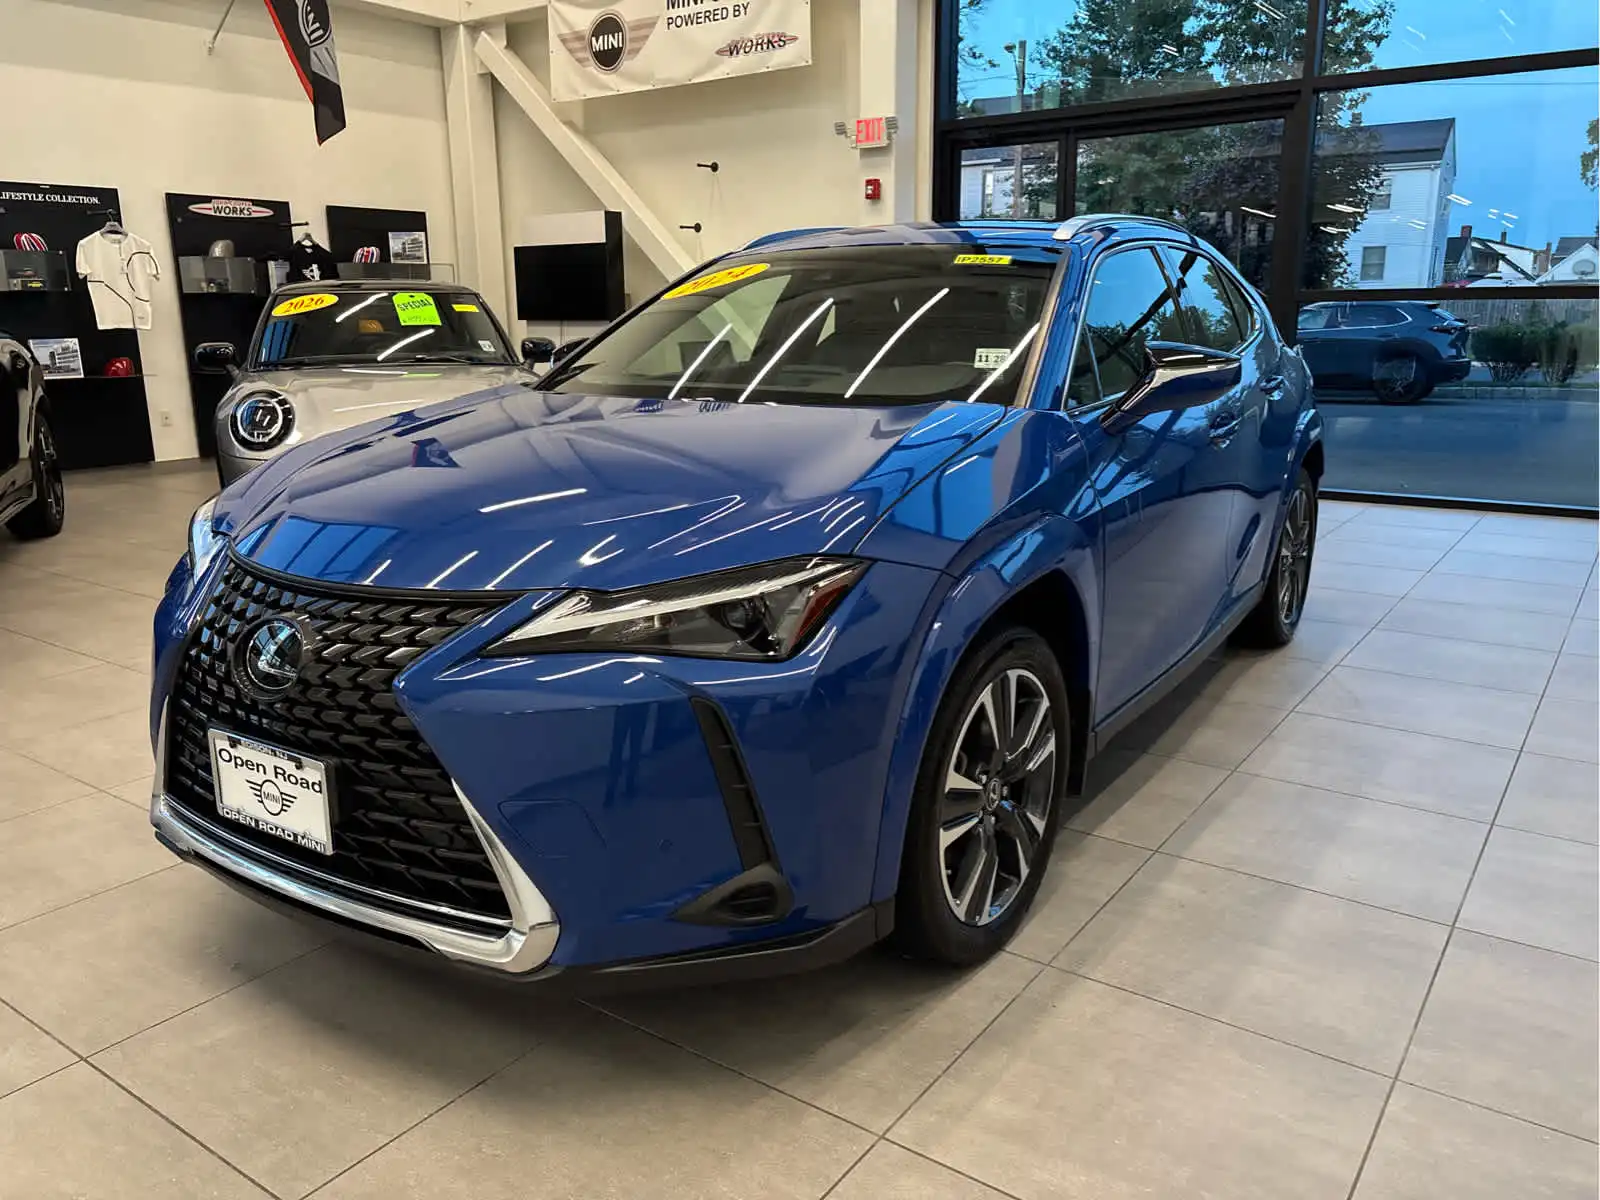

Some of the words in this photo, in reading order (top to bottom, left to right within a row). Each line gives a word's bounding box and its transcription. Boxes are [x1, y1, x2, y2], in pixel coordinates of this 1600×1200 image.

[666, 0, 704, 10] MI
[667, 7, 729, 30] POWERED
[733, 2, 750, 18] BY
[591, 31, 623, 52] MINI
[728, 36, 787, 56] WORKS
[856, 117, 884, 144] EXIT
[45, 194, 101, 204] COLLECTION.
[213, 205, 253, 216] WORKS
[284, 297, 325, 313] 2026
[397, 298, 433, 312] SPECIAL
[978, 354, 990, 363] 11
[218, 748, 267, 775] Open
[273, 765, 323, 795] Road
[263, 791, 281, 805] MINI
[223, 808, 255, 828] OPEN
[259, 821, 294, 840] ROAD
[297, 835, 325, 852] MINI
